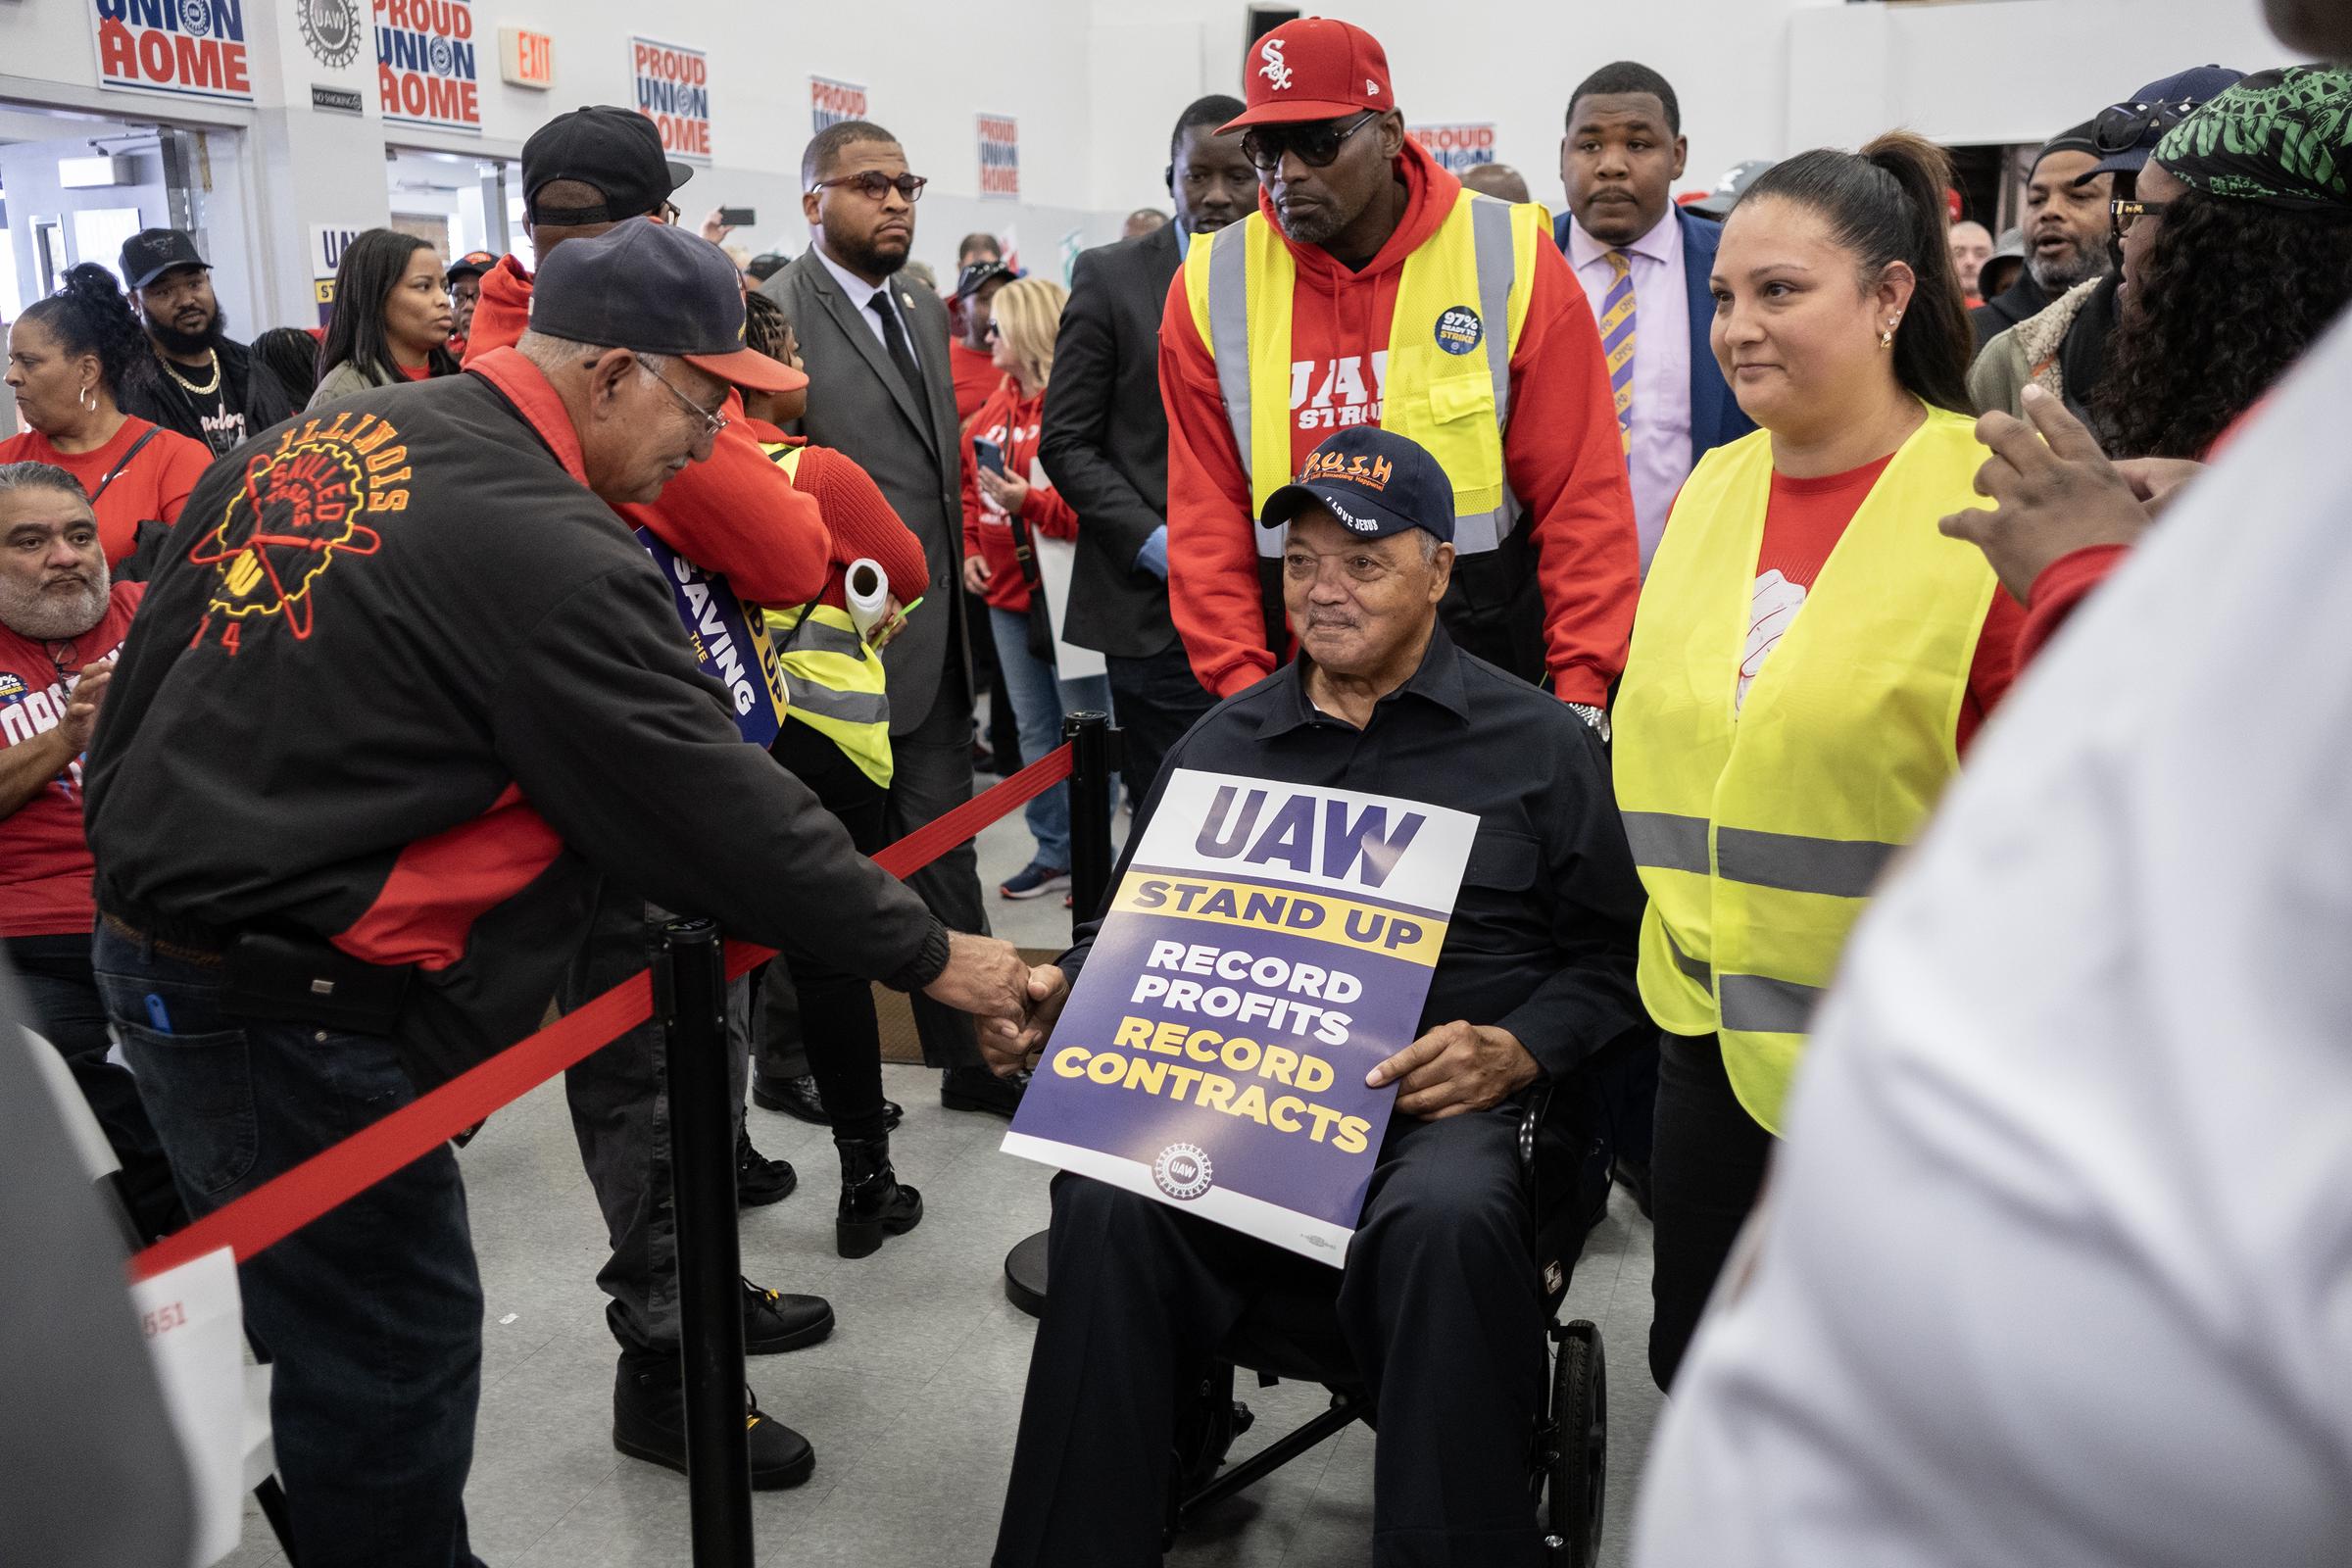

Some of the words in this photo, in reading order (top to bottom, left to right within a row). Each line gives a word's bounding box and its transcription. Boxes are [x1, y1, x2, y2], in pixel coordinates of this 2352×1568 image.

[315, 12, 342, 31] UAW
[372, 0, 472, 39] PROUD
[99, 15, 252, 92] HOME
[374, 25, 476, 79] UNION
[517, 31, 551, 81] EXIT
[635, 43, 707, 86] PROUD
[378, 62, 480, 123] HOME
[637, 76, 710, 119] UNION
[811, 81, 867, 116] PROUD
[640, 105, 711, 155] OME
[1405, 127, 1494, 150] ROUD
[1434, 148, 1494, 173] ION
[322, 230, 356, 269] UA
[1440, 330, 1476, 345] STRIKE
[1441, 323, 1466, 334] READY
[1466, 328, 1478, 337] TO
[1444, 311, 1479, 330] 97%
[1298, 402, 1384, 430] STRO
[275, 412, 413, 513] ILLINOIS
[270, 453, 347, 521] SKILLED
[1332, 501, 1354, 527] LOVE
[1354, 517, 1380, 532] JESUS
[673, 556, 756, 717] SAVING
[689, 630, 710, 664] THE
[762, 644, 785, 704] UP
[1195, 785, 1427, 889] UAW
[1132, 880, 1326, 930] STAND
[1344, 909, 1424, 951] UP
[1146, 940, 1363, 1004] RECORD
[1130, 974, 1353, 1046] PROFITS
[1112, 1015, 1335, 1093] RECORD
[1052, 1047, 1372, 1154] CONTRACTS
[1171, 1160, 1197, 1179] UAW
